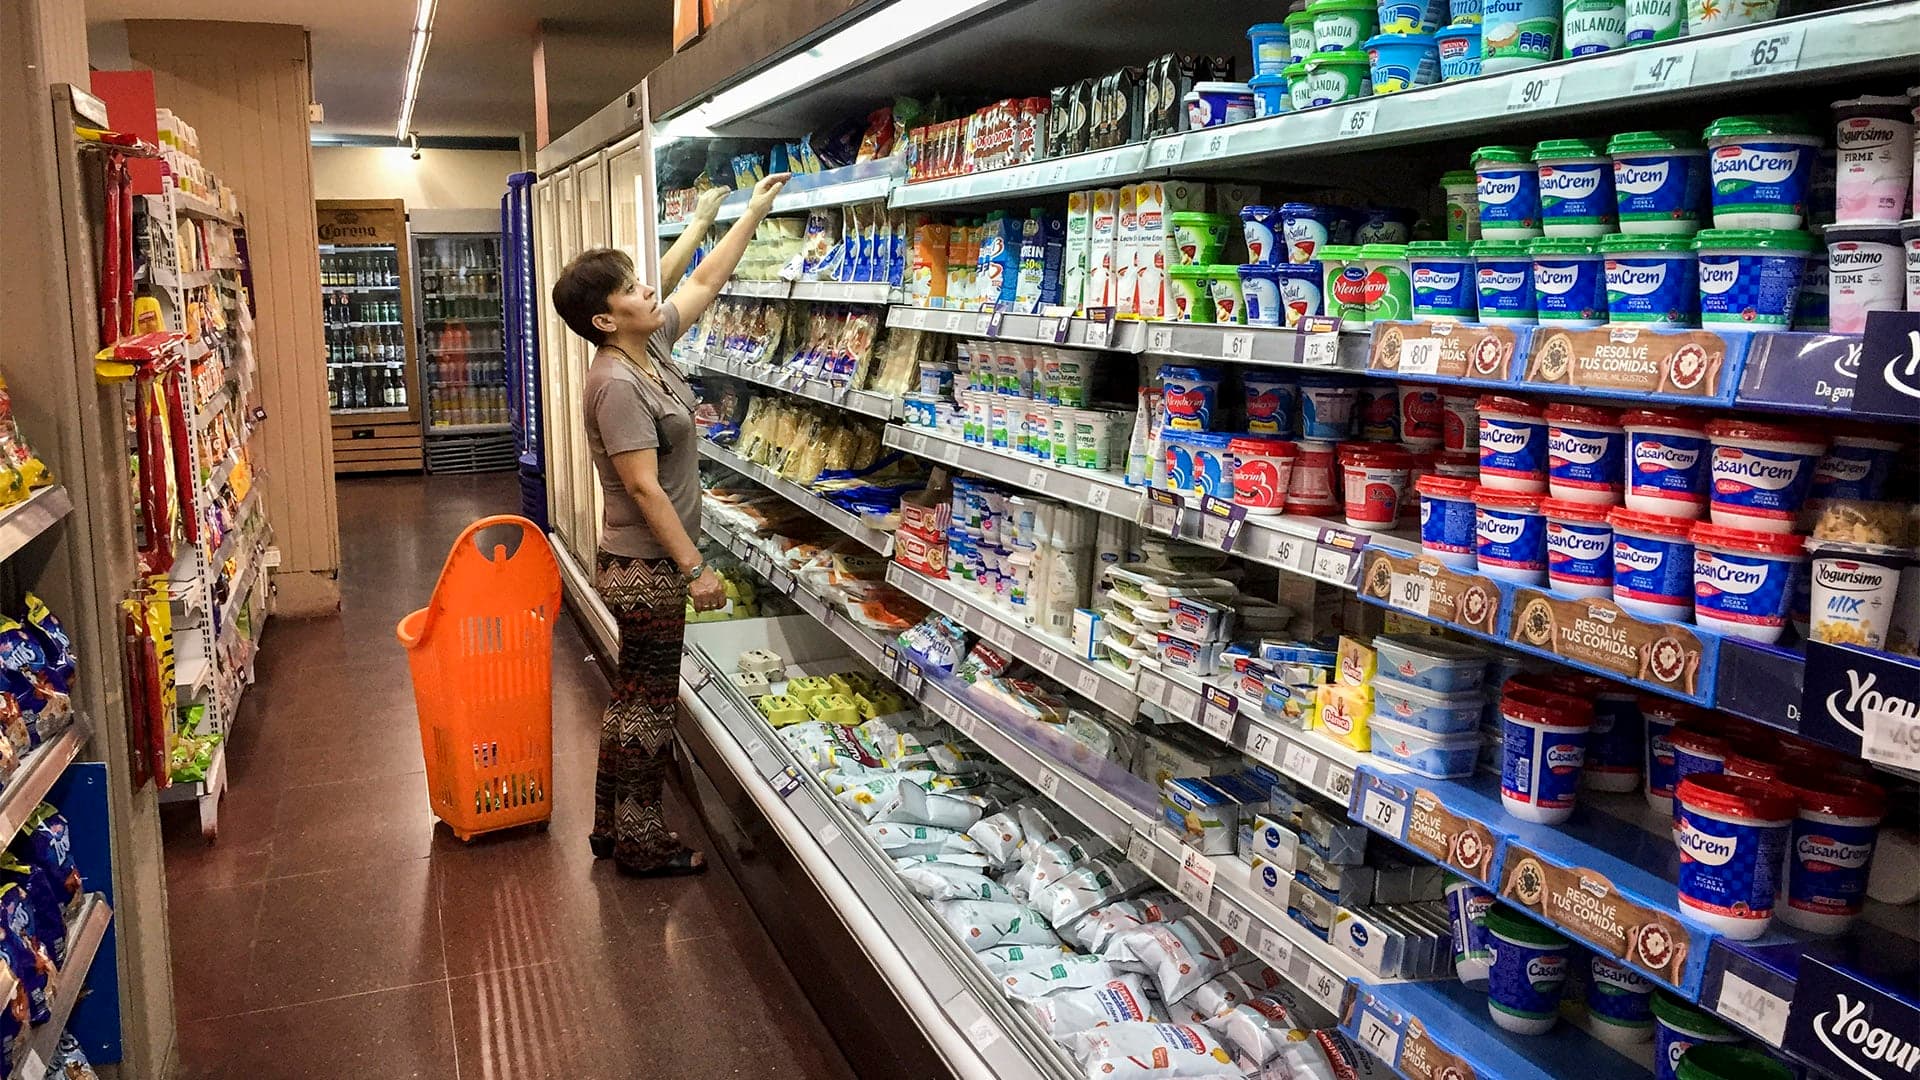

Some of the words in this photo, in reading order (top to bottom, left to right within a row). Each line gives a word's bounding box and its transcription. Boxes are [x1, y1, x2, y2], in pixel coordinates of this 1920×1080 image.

[1567, 17, 1626, 37] FINLANDIA
[1581, 45, 1598, 54] LIGHT
[1712, 154, 1793, 176] CasanCrem
[1845, 152, 1873, 162] FIRME
[318, 224, 377, 241] Corona
[1834, 275, 1863, 284] FIRME
[1595, 344, 1648, 360] RESOLVÉ
[1580, 357, 1601, 370] TUS
[1602, 359, 1658, 374] COMIDAS.
[1815, 381, 1831, 396] Da
[1636, 447, 1694, 464] CasanCrem
[1712, 456, 1793, 481] CasanCrem
[1828, 595, 1865, 614] MIX
[1575, 618, 1627, 643] RESOLVÉ
[1561, 627, 1581, 643] TUS
[1583, 633, 1638, 660] COMIDAS.
[1567, 886, 1617, 920] RESOLVÉ
[1552, 891, 1572, 911] TUS
[1573, 904, 1626, 940] COMIDAS.
